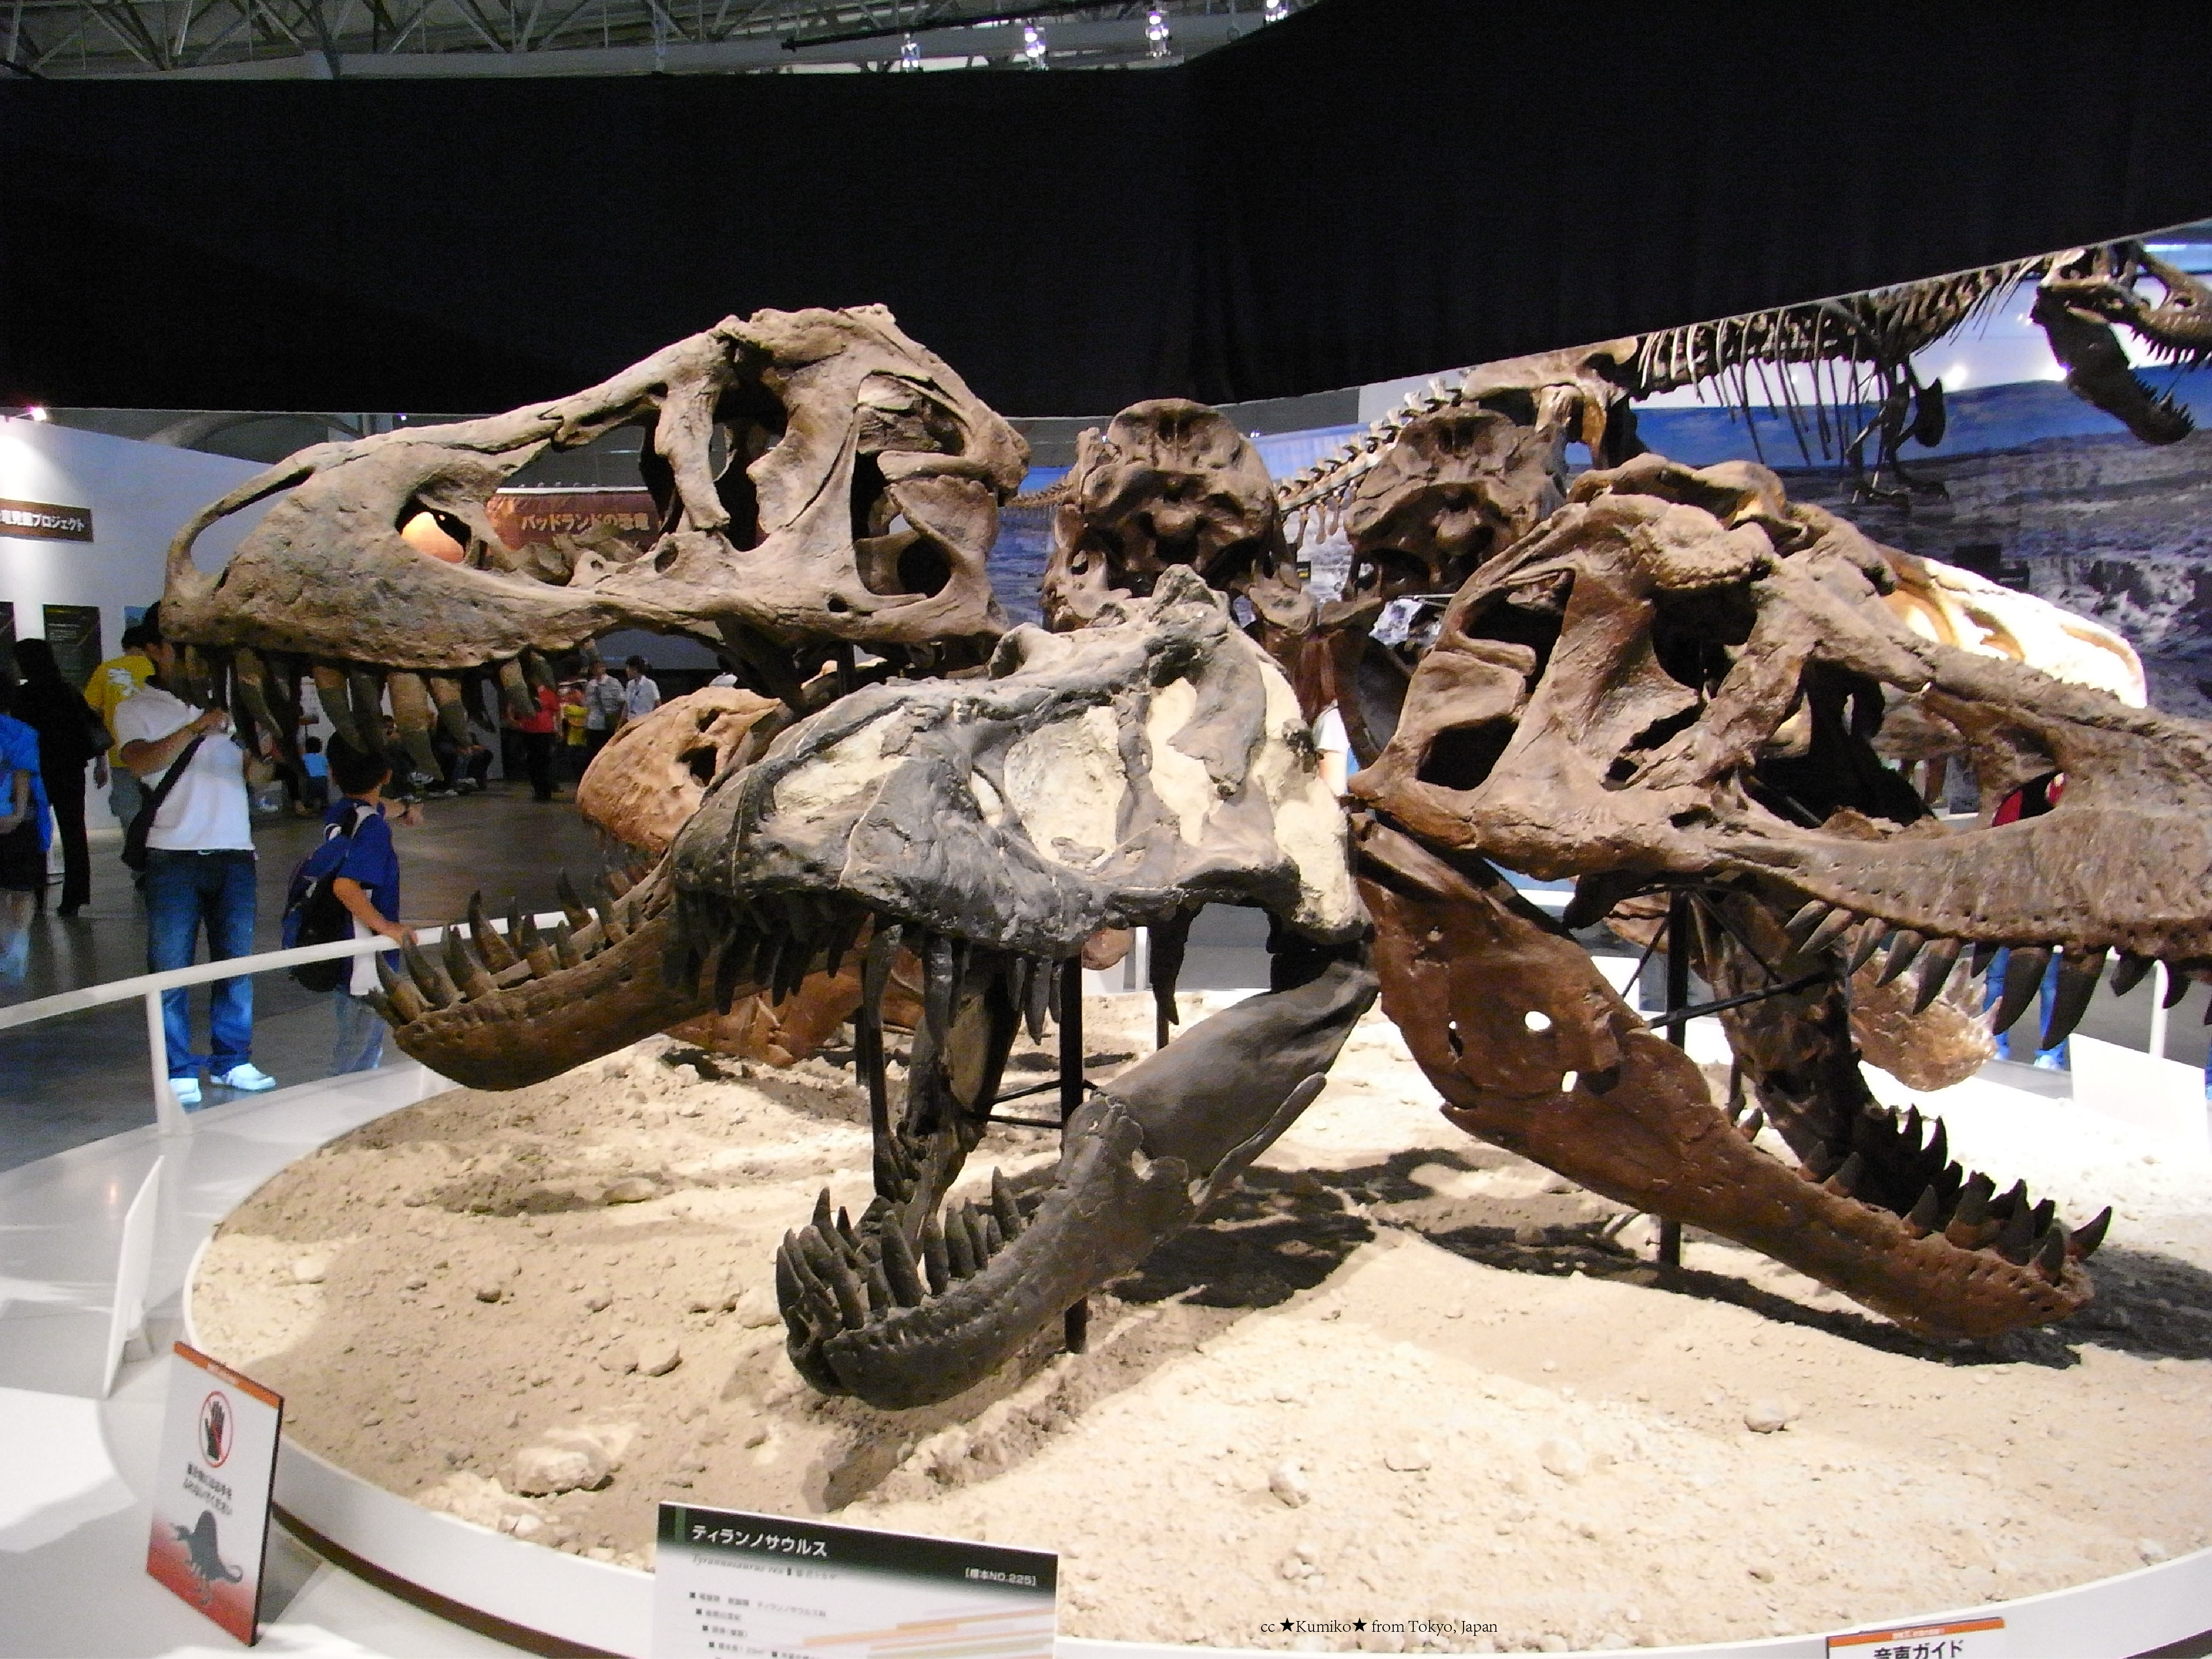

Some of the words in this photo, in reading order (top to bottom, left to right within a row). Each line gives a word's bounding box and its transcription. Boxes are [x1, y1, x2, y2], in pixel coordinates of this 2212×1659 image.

[692, 1524, 827, 1557] ティランノサウルス
